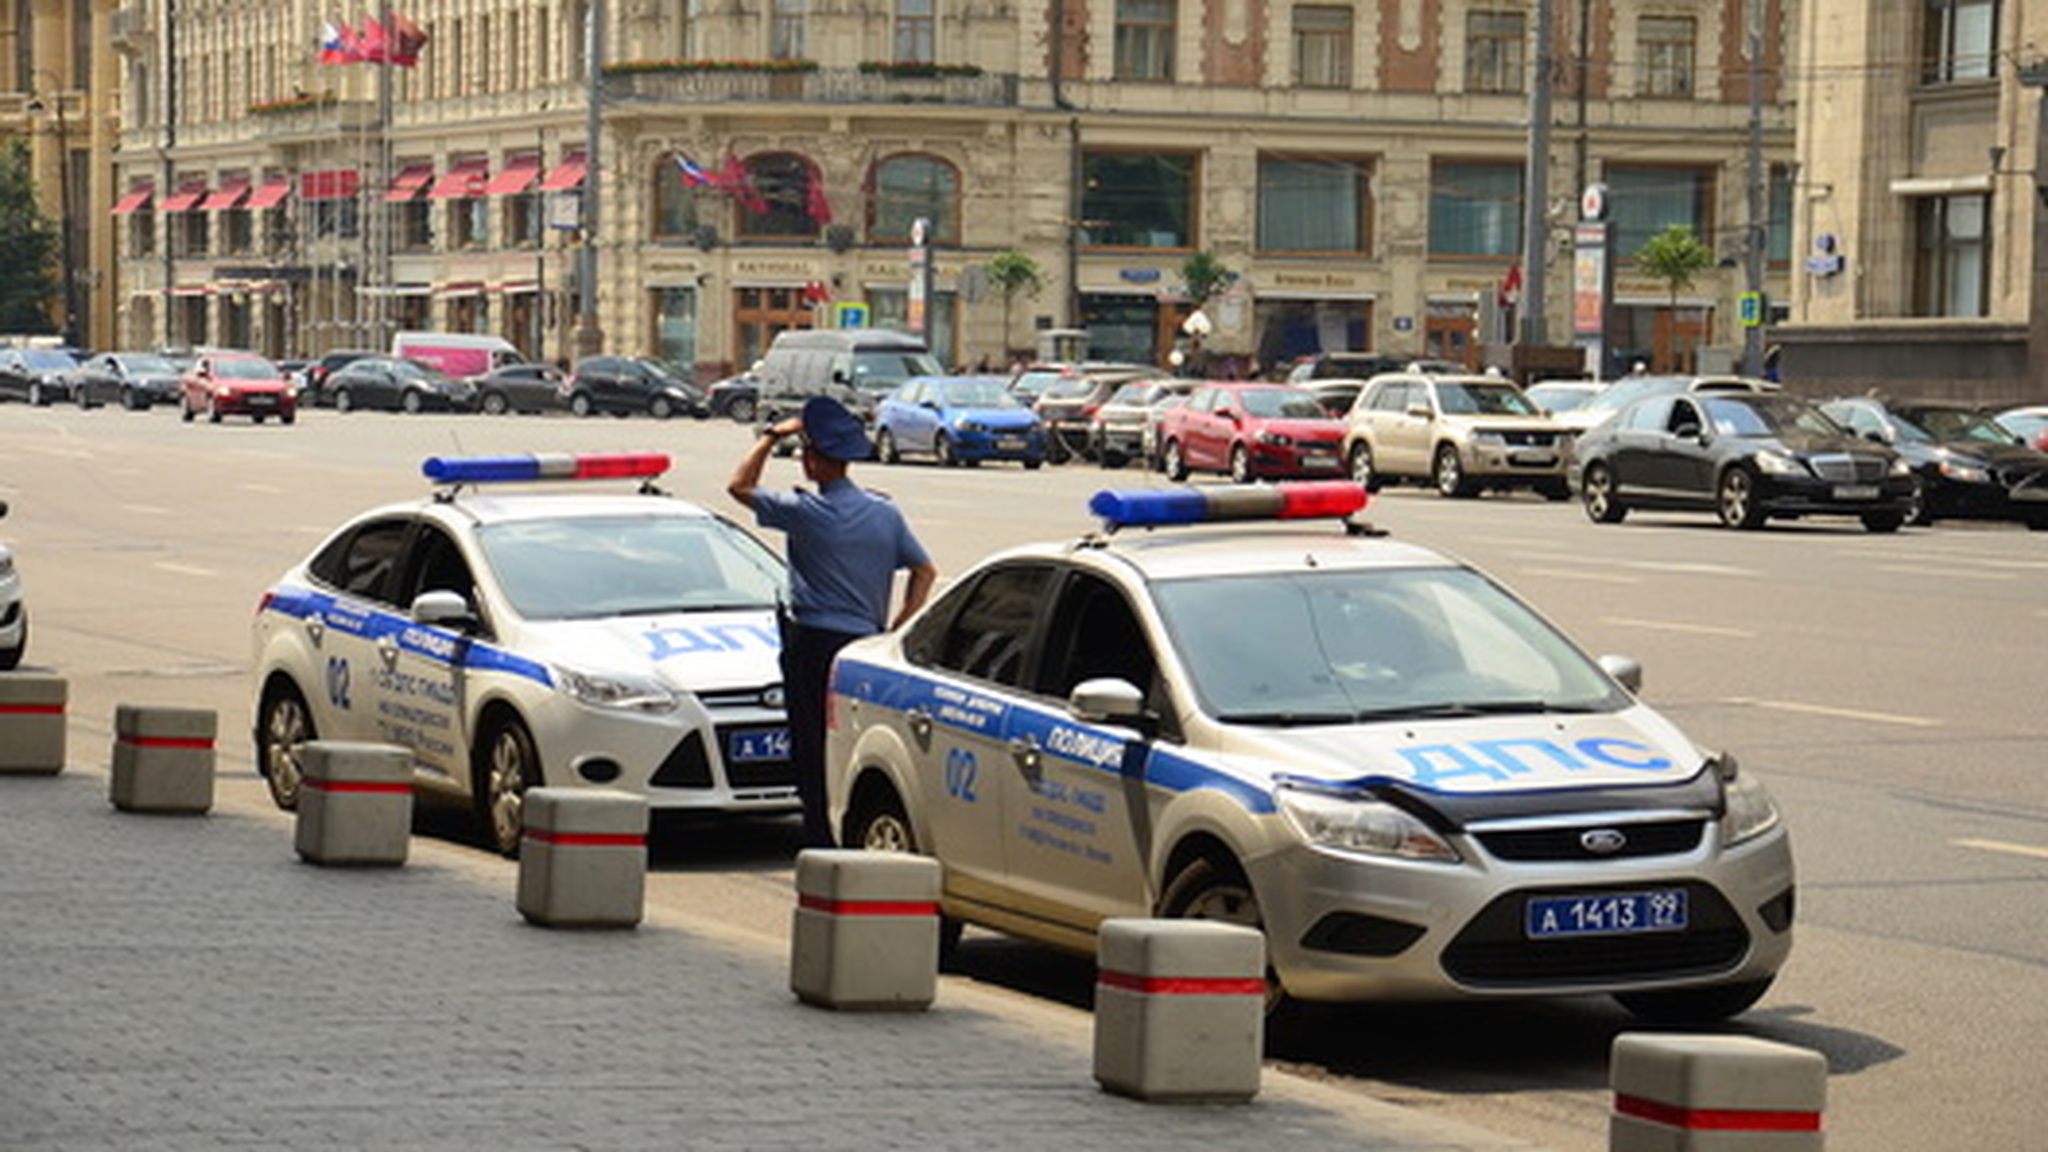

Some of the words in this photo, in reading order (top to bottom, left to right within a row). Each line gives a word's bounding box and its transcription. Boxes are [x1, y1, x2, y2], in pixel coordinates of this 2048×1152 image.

[645, 626, 780, 659] ДП
[327, 656, 350, 709] 02
[762, 732, 791, 757] 14
[1047, 726, 1123, 768] ПОЛИЦИЯ
[1396, 737, 1672, 789] ДПС
[947, 748, 976, 803] 02
[1542, 908, 1558, 932] А
[1570, 897, 1636, 930] 1413
[1650, 893, 1677, 917] 99
